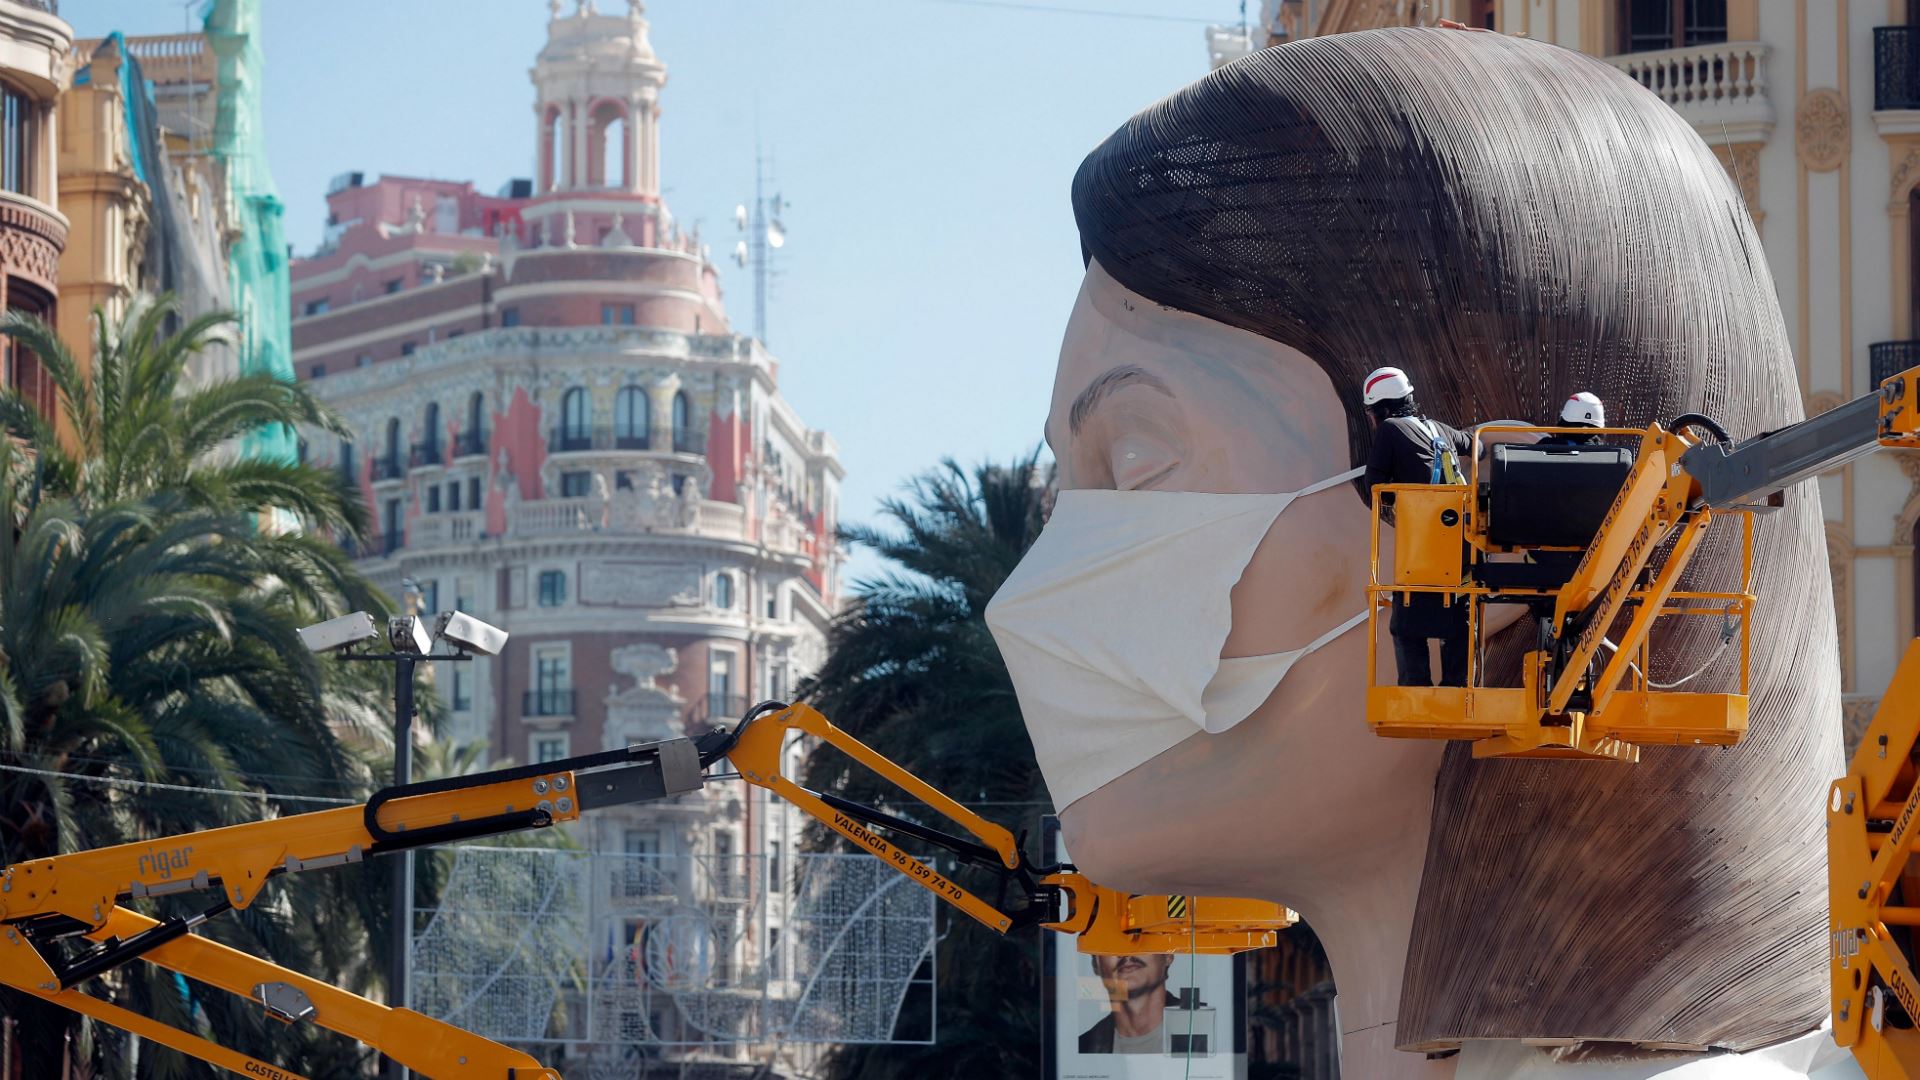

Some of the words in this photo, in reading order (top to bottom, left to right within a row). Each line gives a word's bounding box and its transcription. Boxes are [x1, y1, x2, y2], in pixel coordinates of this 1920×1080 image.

[1578, 530, 1604, 575] VALENCIA
[1622, 482, 1630, 499] 74
[1630, 468, 1638, 486] 70
[1580, 590, 1613, 654] CASTELLON
[1641, 525, 1649, 546] 00
[138, 846, 194, 880] rigar
[834, 813, 888, 854] VALENCIA
[893, 851, 906, 865] 96
[909, 862, 931, 879] 159
[931, 875, 947, 890] 74
[947, 886, 963, 901] 70
[245, 1061, 298, 1080] CASTELL
